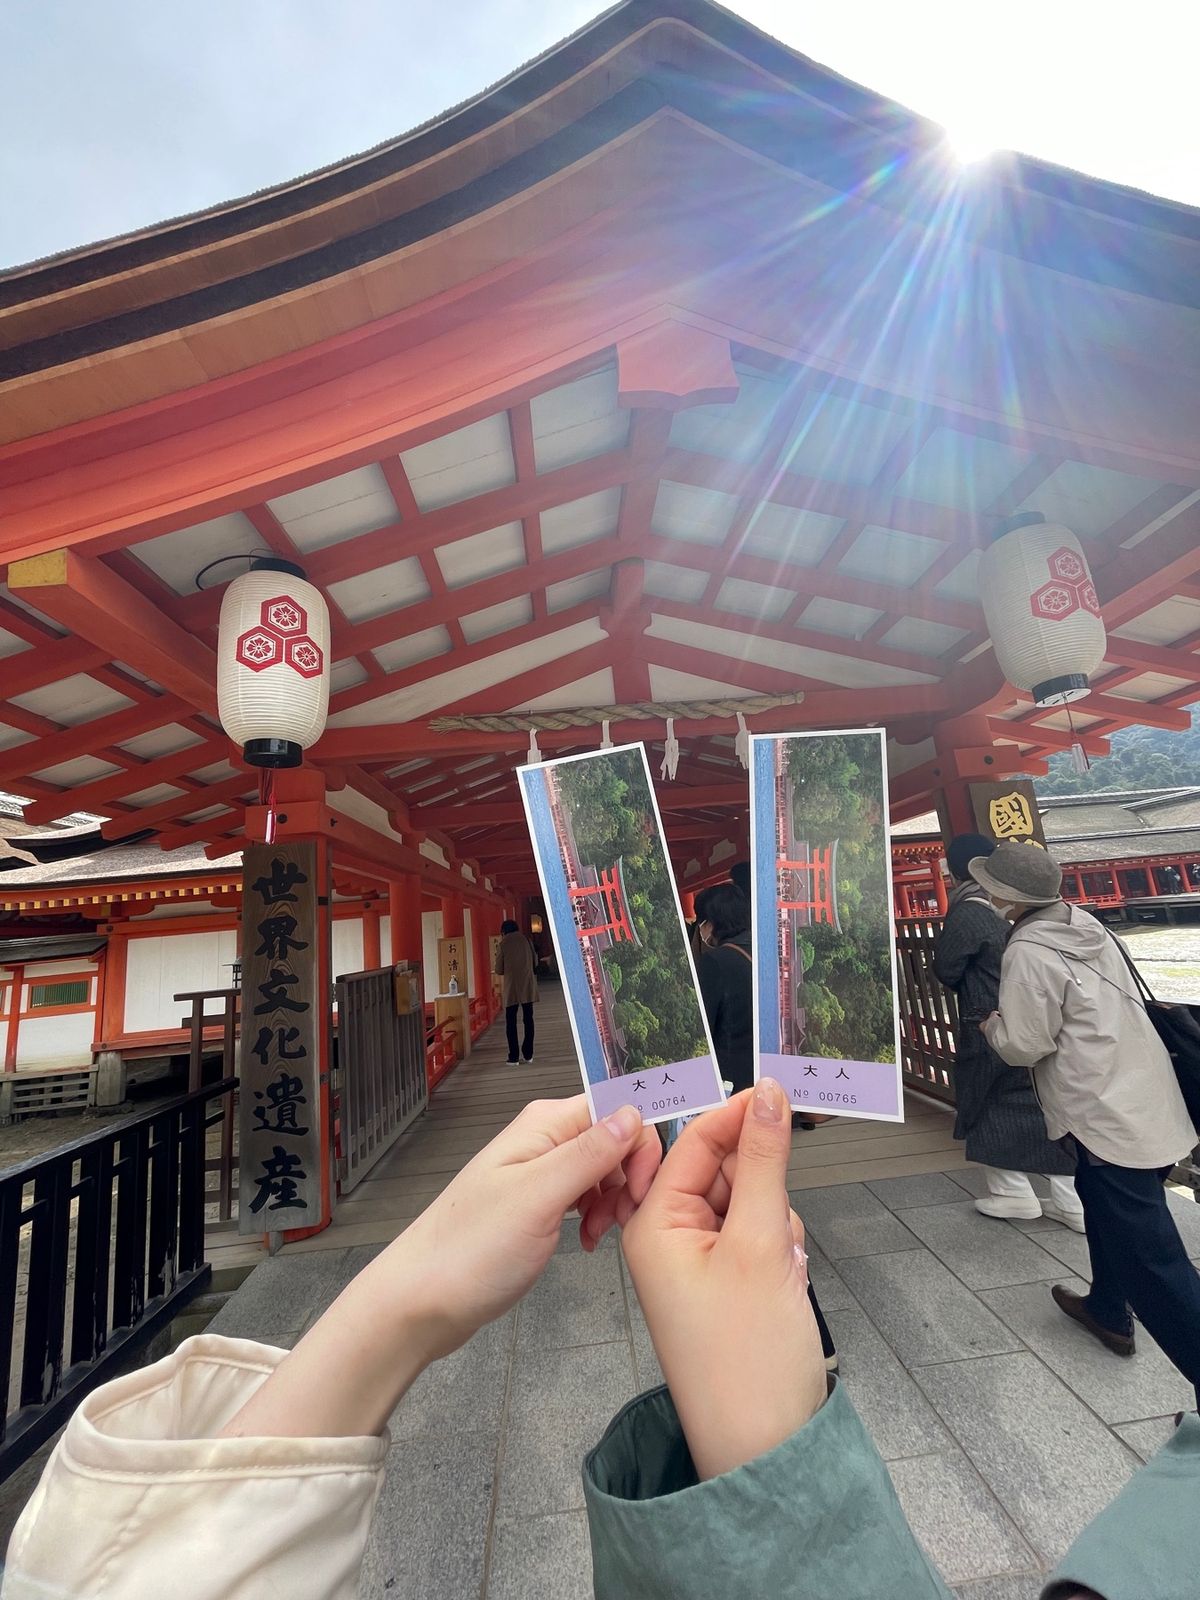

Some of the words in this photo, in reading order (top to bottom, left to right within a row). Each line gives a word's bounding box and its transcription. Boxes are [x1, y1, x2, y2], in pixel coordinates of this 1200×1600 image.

[250, 858, 309, 1214] 世界文化遺産
[651, 1095, 687, 1111] 00764
[818, 1091, 857, 1104] 00765
